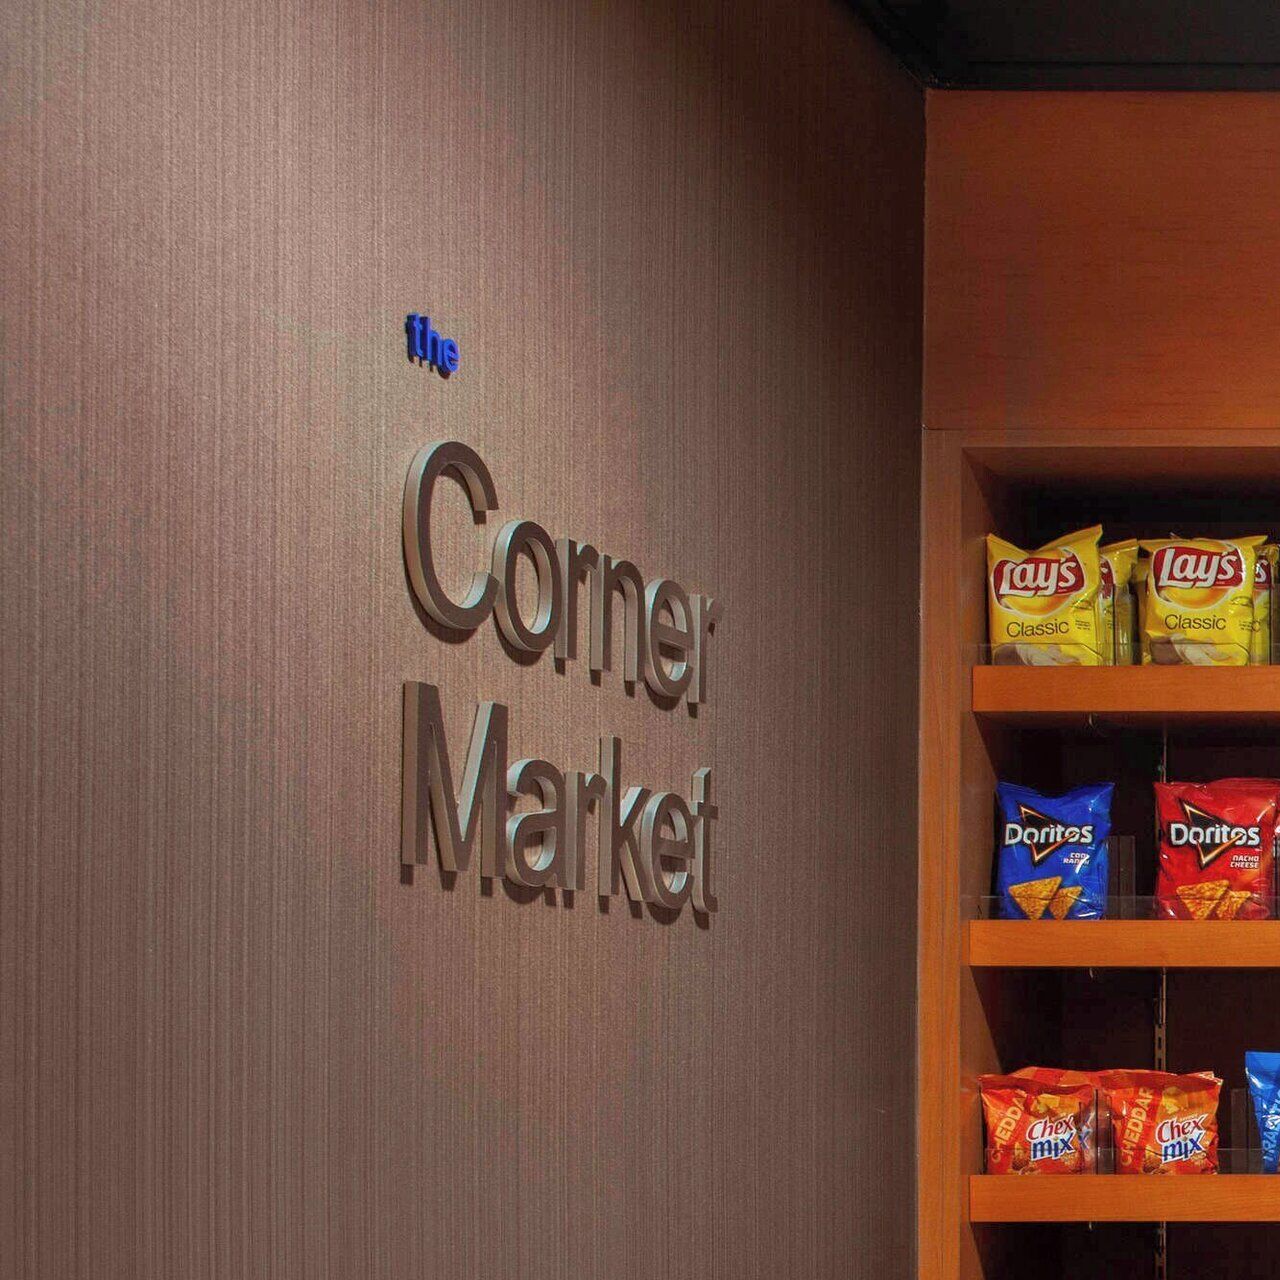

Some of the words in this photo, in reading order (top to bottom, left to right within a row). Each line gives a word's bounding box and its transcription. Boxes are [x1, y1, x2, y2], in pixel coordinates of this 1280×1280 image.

[405, 312, 460, 375] the
[403, 440, 721, 704] Corner
[1000, 557, 1076, 597] Lay's
[1159, 548, 1243, 588] Lay's
[1006, 618, 1070, 638] Classic
[1164, 614, 1226, 631] Classic
[402, 680, 719, 913] Market
[1005, 823, 1093, 845] Doritos
[1170, 823, 1260, 845] Doritos
[1027, 1114, 1074, 1141] Chex
[1121, 1087, 1154, 1166] CHEDDAR
[1156, 1114, 1207, 1142] Chex
[1031, 1133, 1074, 1159] mix
[1162, 1133, 1201, 1161] mix
